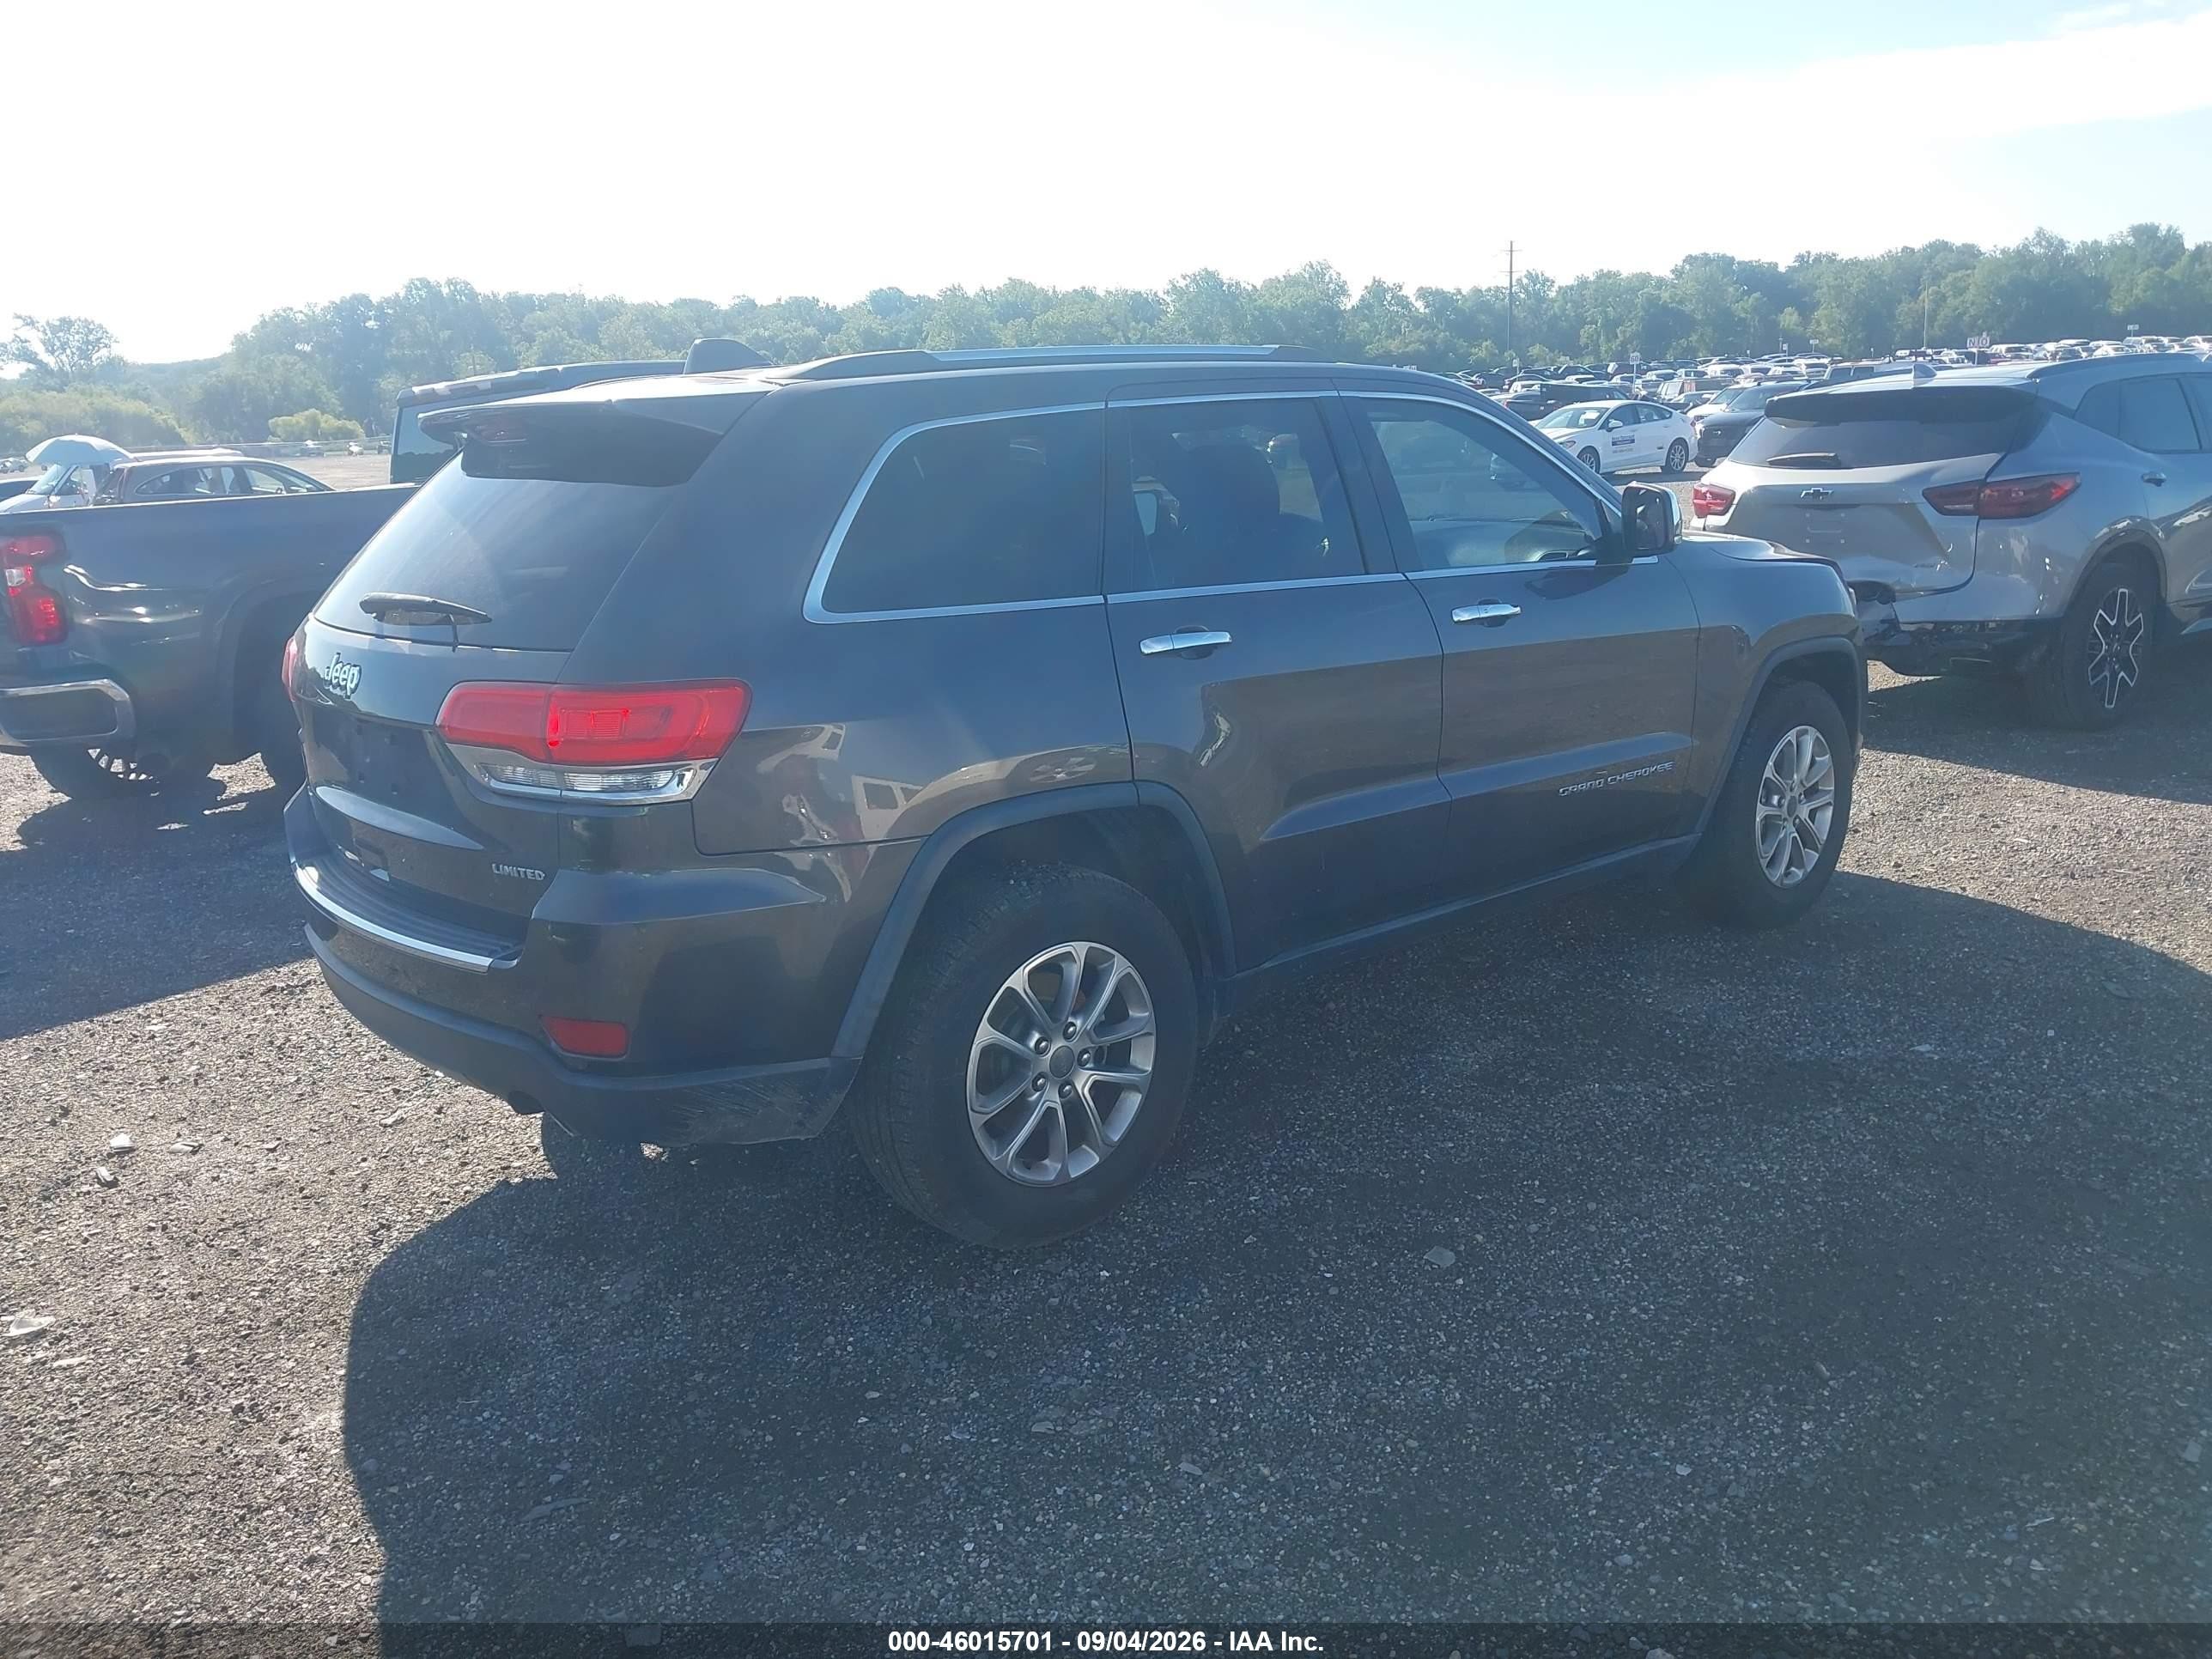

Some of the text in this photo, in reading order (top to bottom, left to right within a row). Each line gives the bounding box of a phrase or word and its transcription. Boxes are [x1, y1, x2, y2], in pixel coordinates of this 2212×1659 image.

[324, 653, 362, 698] Jeep
[1559, 761, 1675, 797] GRAND CHEROKEE
[491, 863, 546, 881] LIMITED
